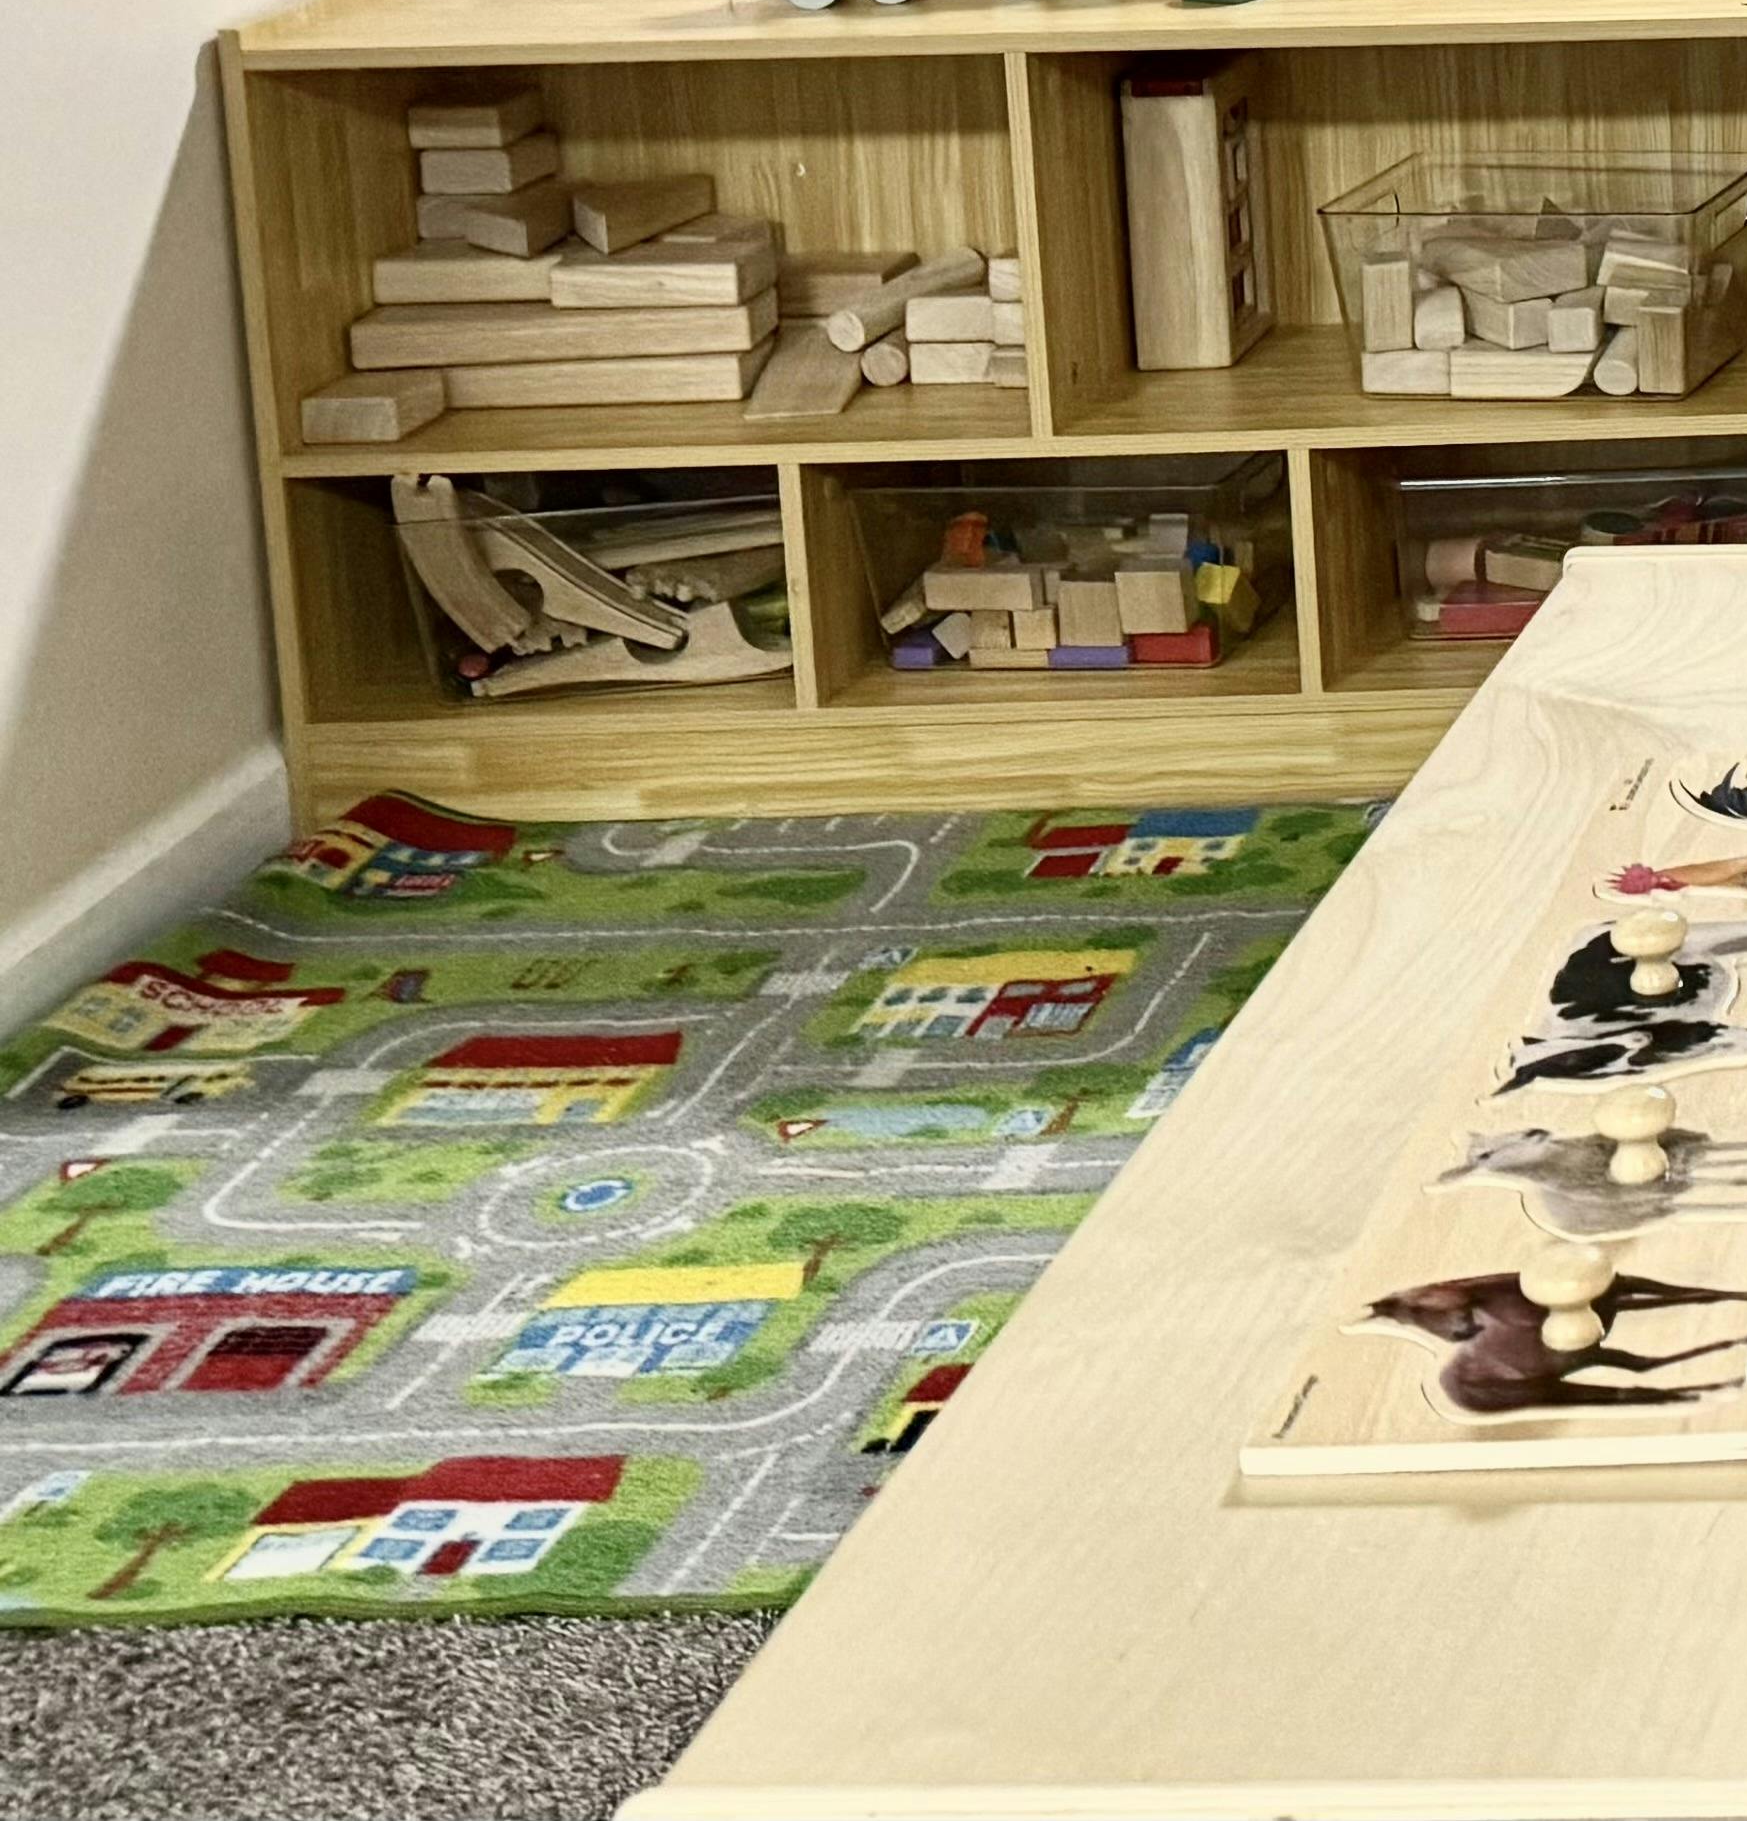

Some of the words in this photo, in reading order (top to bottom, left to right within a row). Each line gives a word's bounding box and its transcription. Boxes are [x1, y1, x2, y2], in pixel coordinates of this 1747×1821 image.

[95, 1269, 223, 1298] FIRE
[231, 1270, 404, 1294] HOUSE
[547, 1320, 730, 1347] POLICE
